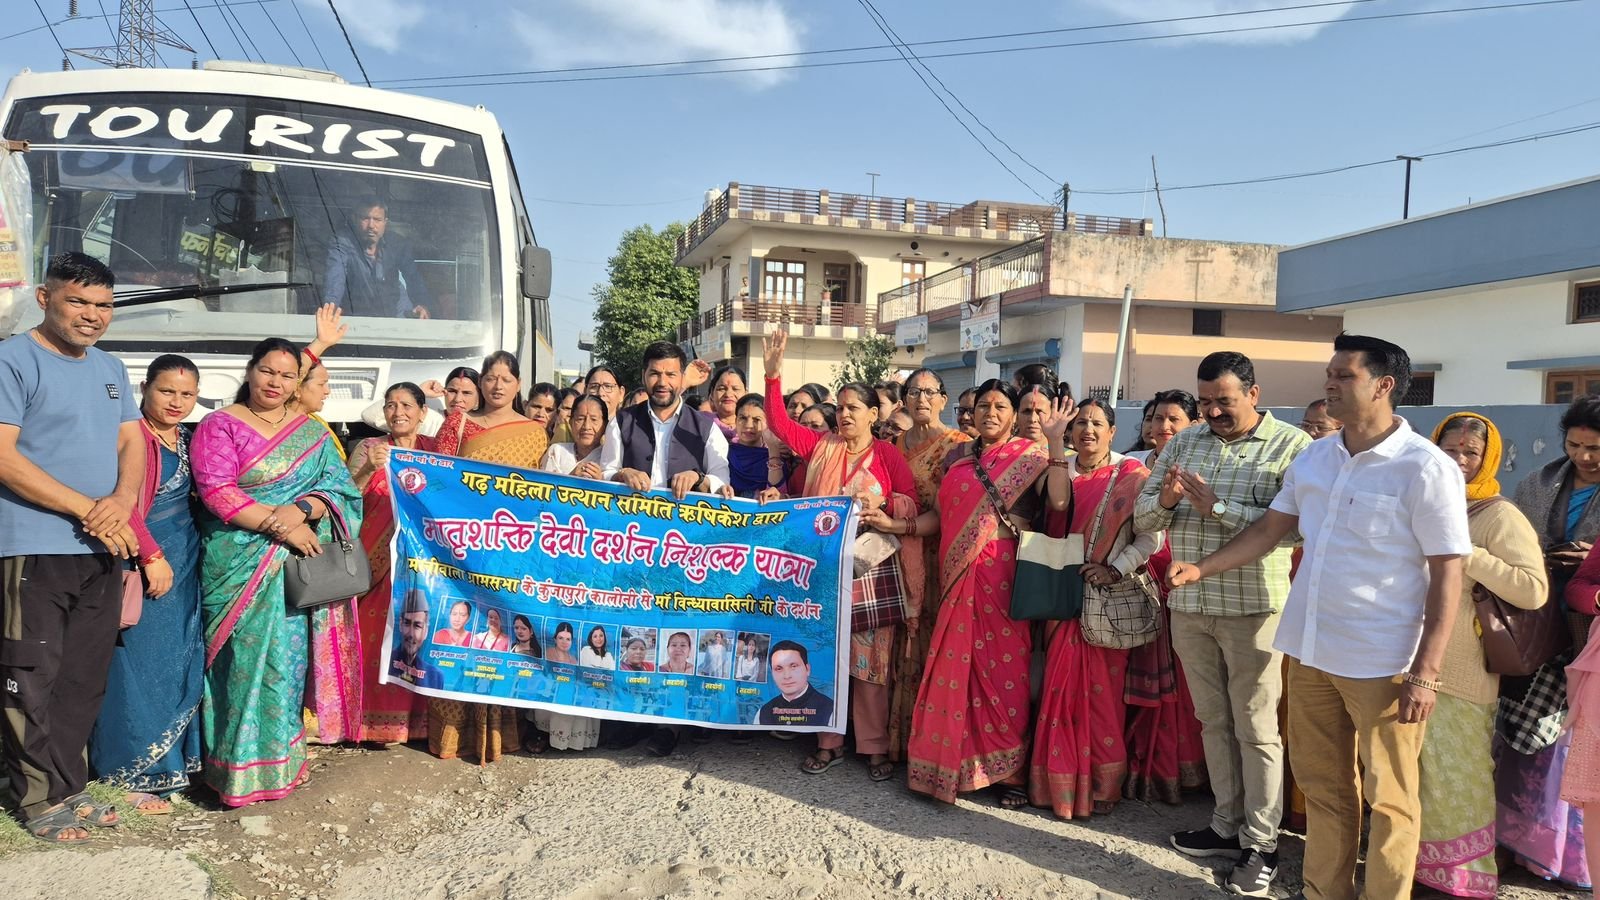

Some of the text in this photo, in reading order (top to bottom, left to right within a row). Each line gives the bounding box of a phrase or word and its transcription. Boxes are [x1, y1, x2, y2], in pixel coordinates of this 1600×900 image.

[40, 104, 457, 168] TOURIST
[428, 455, 438, 466] के
[461, 471, 490, 496] गढ़
[494, 472, 554, 502] महिला
[557, 485, 612, 511] उत्थान
[679, 501, 751, 528] ऋषिकेश
[752, 510, 788, 527] द्वारा
[423, 508, 817, 589] मातृशक्ति देवी दर्शन निशुल्क यात्रा
[466, 571, 521, 593] ग्रामसभा
[521, 575, 536, 596] के
[537, 578, 590, 605] कुंजापुरी
[590, 587, 640, 608] कालोनी
[640, 588, 654, 609] से
[673, 591, 757, 614] विन्ध्यावासिनी
[758, 594, 775, 615] जी
[776, 596, 790, 617] के
[790, 598, 821, 620] दर्शन
[7, 678, 18, 693] 03
